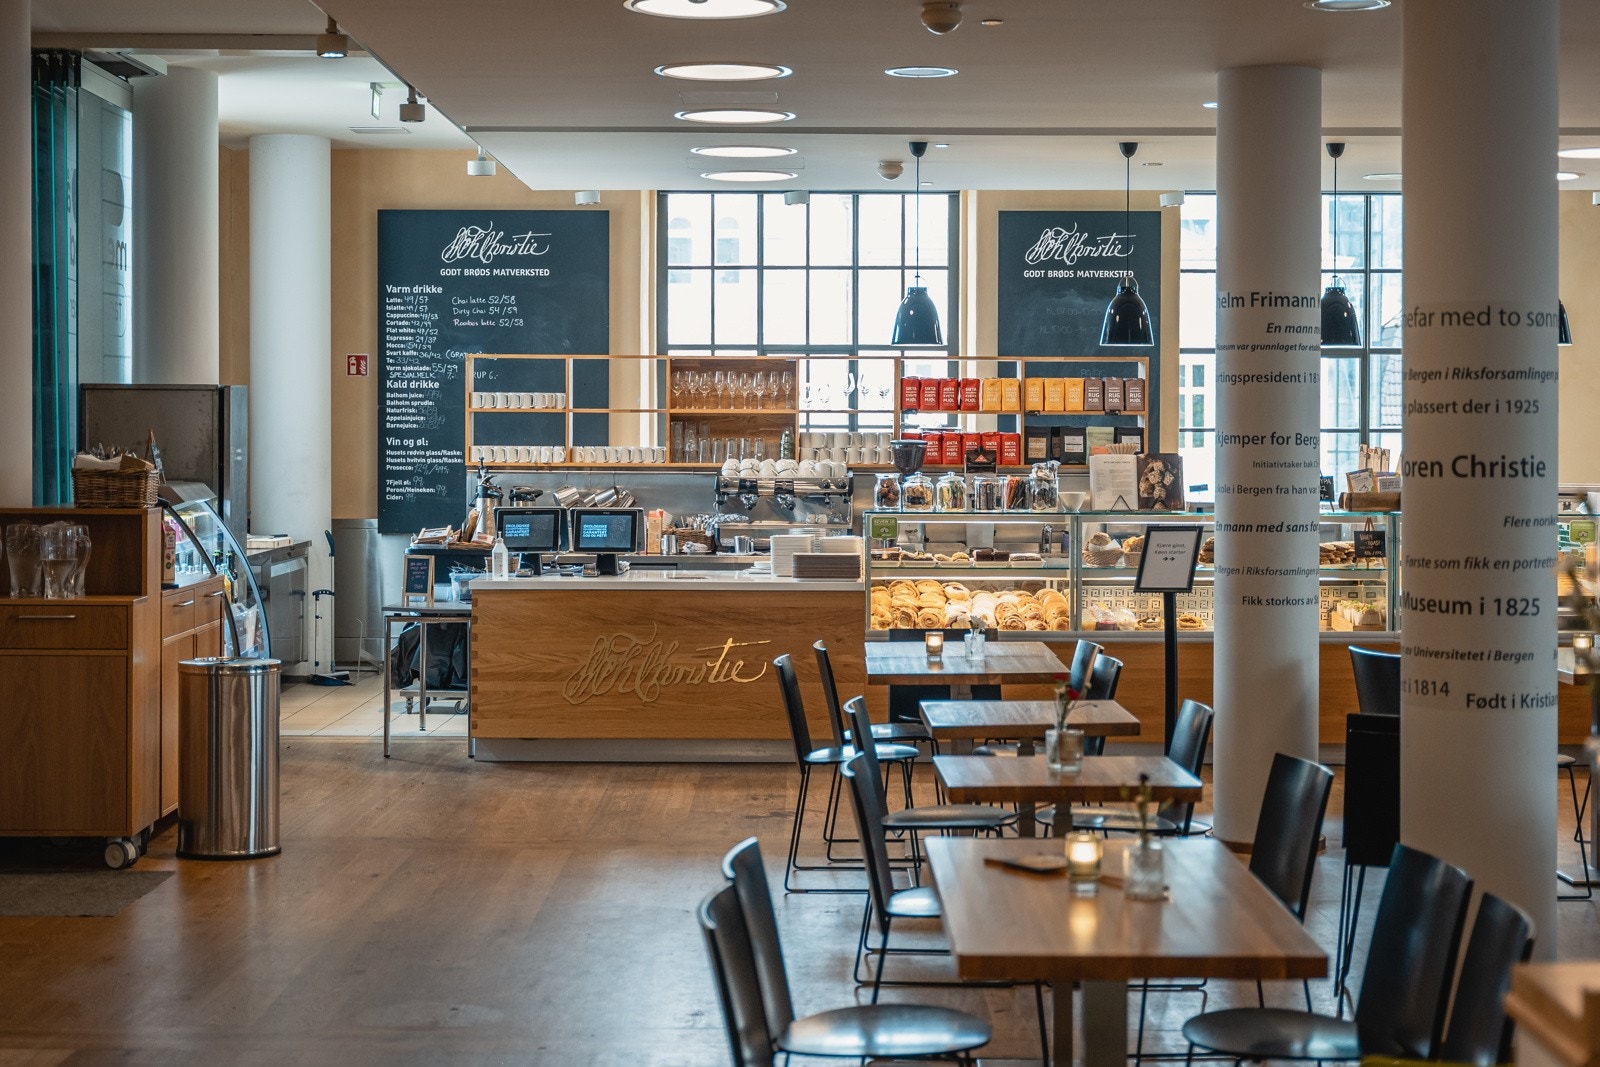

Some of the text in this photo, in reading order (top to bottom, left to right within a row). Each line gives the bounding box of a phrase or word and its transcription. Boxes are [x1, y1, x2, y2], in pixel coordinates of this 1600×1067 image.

[440, 268, 550, 277] GODT BRØDS MATVERKSTED
[1023, 270, 1134, 279] GODT BRØDS MATVERKSTED
[386, 284, 443, 294] Varm drikke
[451, 294, 516, 305] Chai latte 52/58
[1249, 292, 1316, 308] Frimann
[452, 307, 470, 317] Dirty
[1405, 305, 1558, 328] efar med to sønn
[498, 318, 524, 328] 52/58
[1266, 322, 1282, 333] En
[1284, 324, 1313, 334] mann
[386, 335, 414, 343] Espresso:
[1236, 343, 1250, 351] var
[1250, 343, 1298, 352] grunnlaget
[1297, 342, 1309, 351] for
[1217, 371, 1302, 385] rtingspresident
[1303, 371, 1307, 383] i
[1408, 368, 1441, 383] Bergen
[1444, 367, 1449, 380] i
[1451, 367, 1553, 383] Riksforsamlingen
[386, 380, 440, 389] Kald drikke
[1407, 399, 1540, 416] plassert der i 1925
[386, 437, 429, 448] Vin og øl:
[1217, 431, 1267, 448] kjemper
[1269, 431, 1292, 446] for
[1252, 460, 1302, 468] Initiativtaker
[1303, 460, 1313, 468] bak
[1404, 455, 1547, 478] oren Christie
[1237, 485, 1273, 496] Bergen
[1275, 484, 1289, 495] fra
[1291, 484, 1308, 495] han
[1224, 523, 1253, 533] mann
[1255, 521, 1283, 533] med
[1286, 522, 1309, 533] sans
[1503, 515, 1531, 528] Flere
[1533, 514, 1557, 528] norsk
[1405, 555, 1431, 568] Første
[1433, 558, 1460, 570] som
[1463, 555, 1489, 570] fikk
[1493, 558, 1509, 570] en
[1218, 565, 1240, 577] Bergen
[1246, 566, 1315, 577] Riksforsamlingen
[1242, 595, 1263, 606] Fikk
[1265, 596, 1305, 606] storkors
[1306, 597, 1314, 606] av
[1402, 591, 1541, 617] Museum i 1825
[1413, 646, 1484, 661] Universitetet
[1487, 648, 1492, 660] i
[1493, 648, 1534, 664] Bergen
[1414, 679, 1450, 696] 1814
[1466, 693, 1506, 709] Født
[1511, 693, 1515, 708] i
